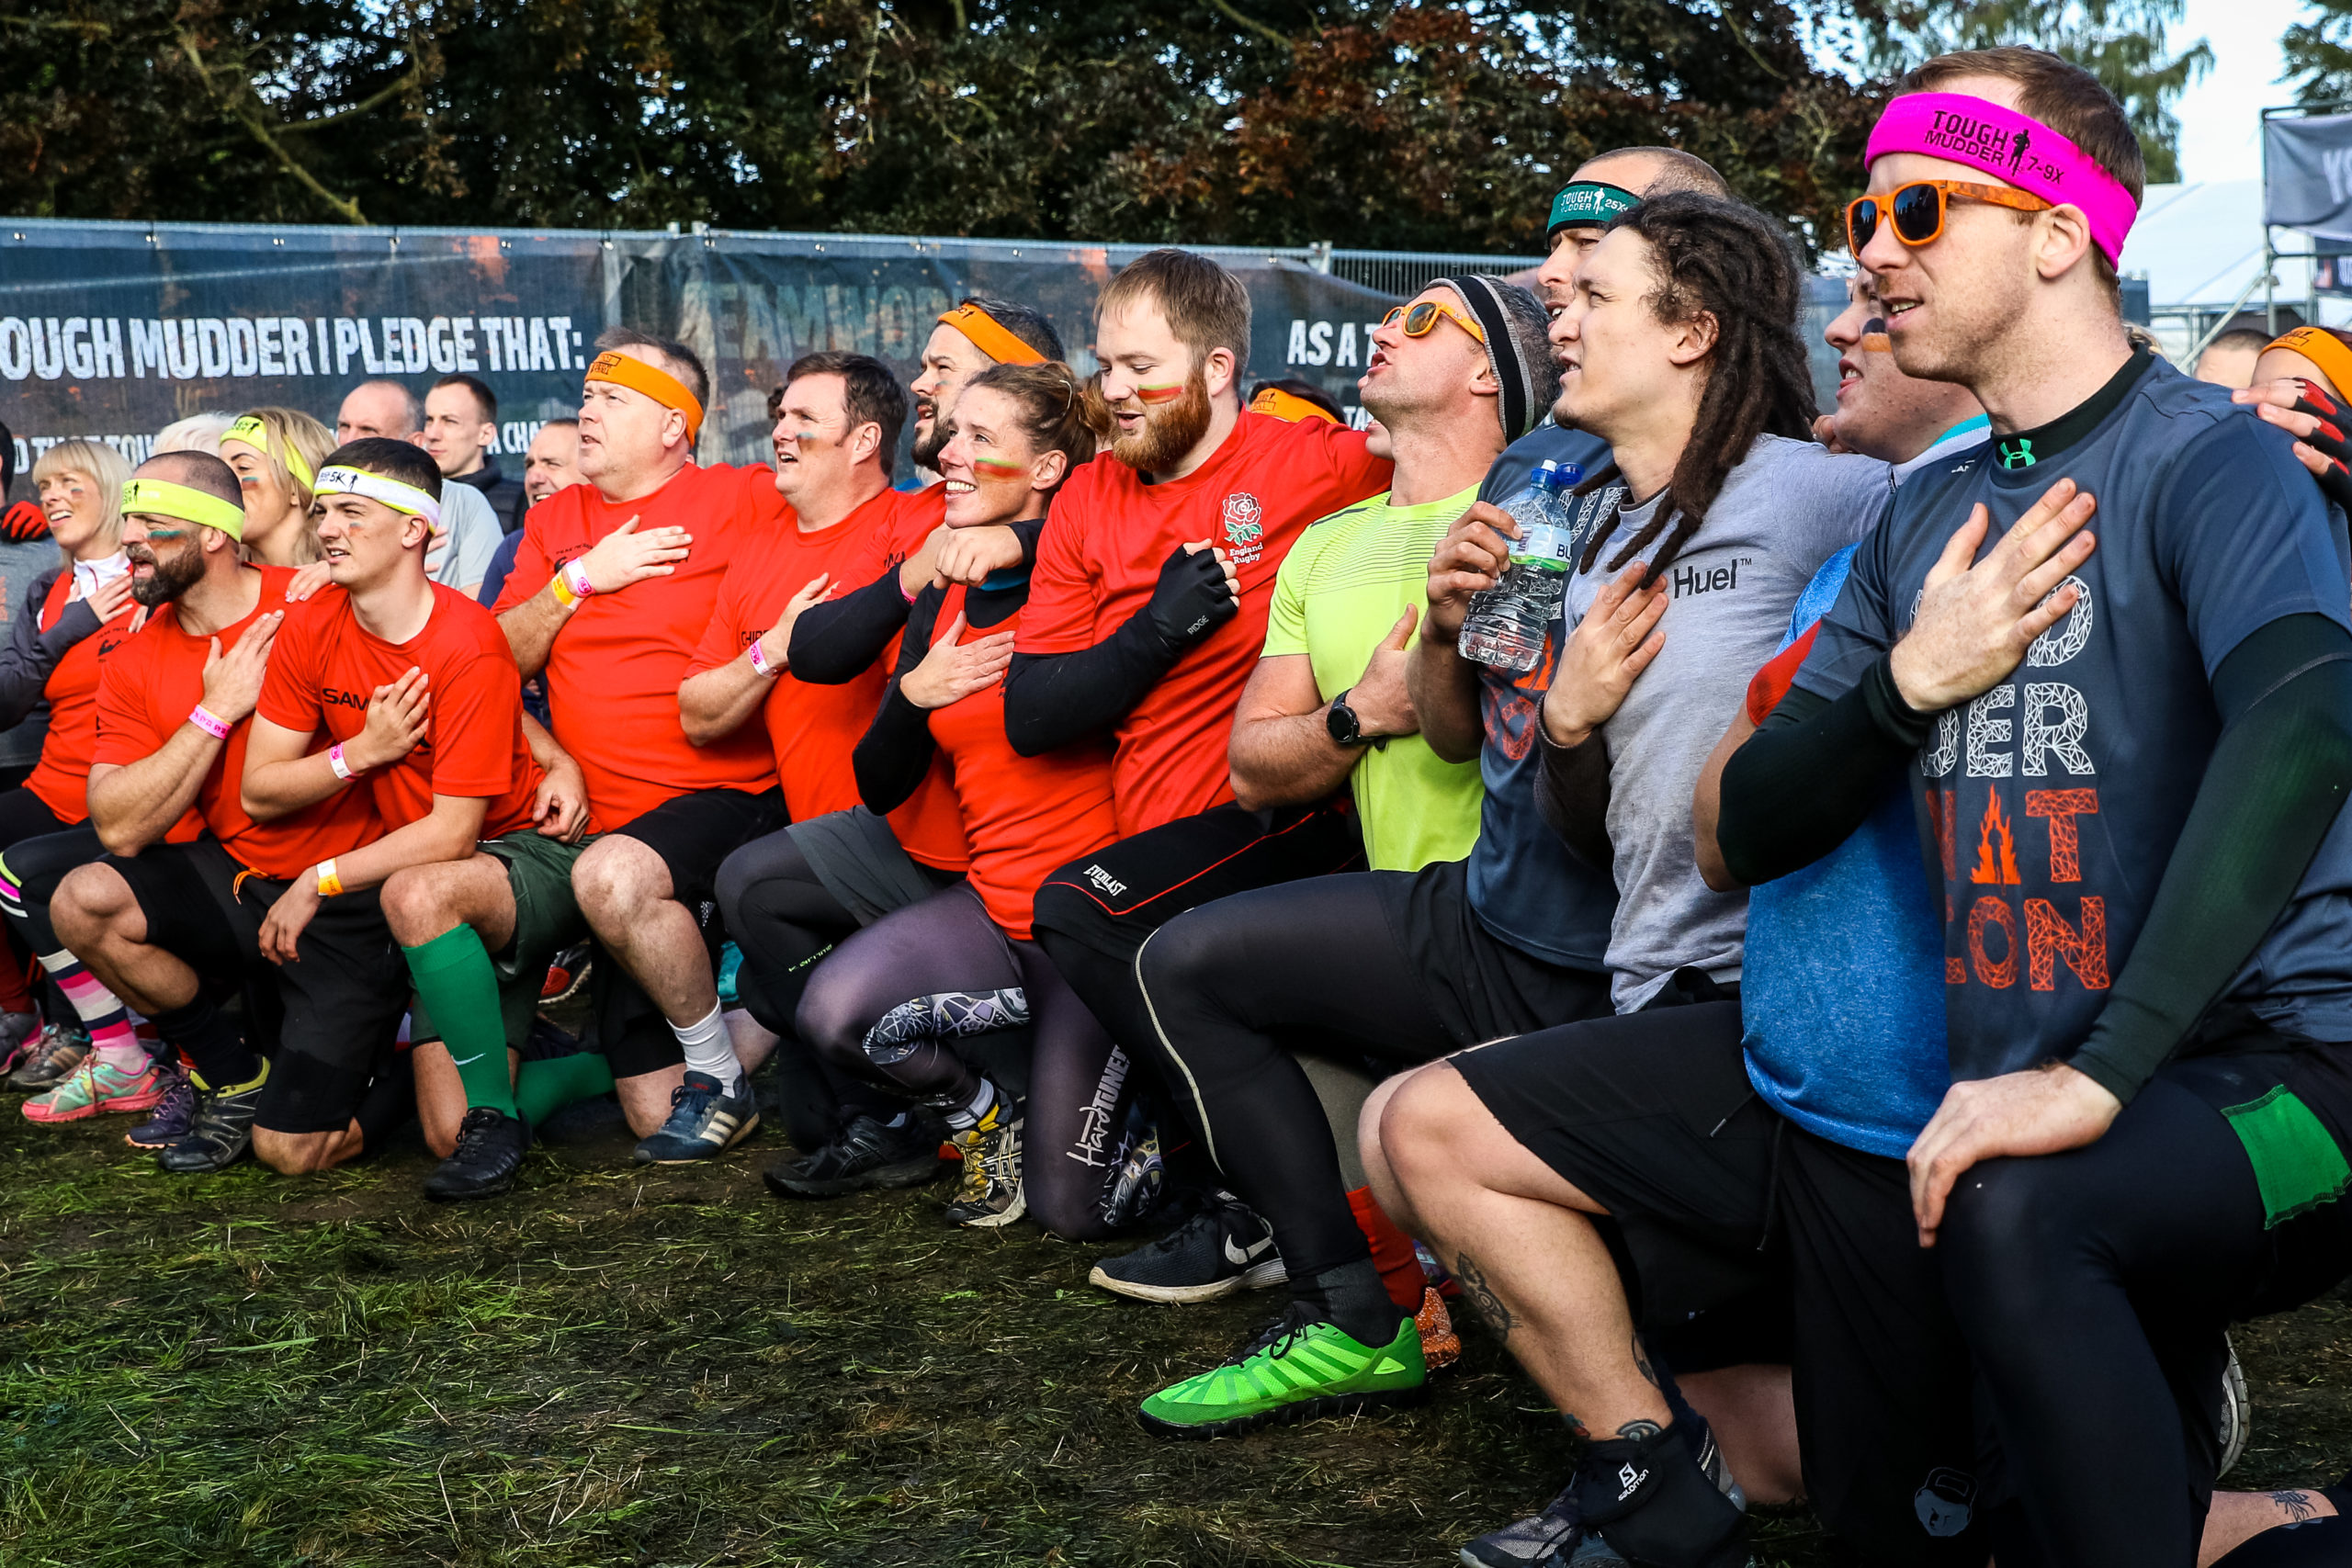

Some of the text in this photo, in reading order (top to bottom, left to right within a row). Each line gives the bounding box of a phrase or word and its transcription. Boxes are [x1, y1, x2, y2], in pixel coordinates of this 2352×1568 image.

[1933, 110, 2009, 151] TOUGH
[1925, 130, 2005, 166] MUDDER
[2028, 156, 2064, 184] 7-9X
[129, 317, 314, 379] MUDDER
[315, 317, 331, 375] I
[334, 316, 479, 375] PLEDGE
[479, 316, 585, 371] THAT:
[1287, 320, 1333, 366] AS
[1336, 322, 1357, 367] A
[1229, 542, 1263, 557] England
[1233, 553, 1261, 565] Rugby
[1674, 559, 1737, 599] Huel
[1187, 615, 1209, 635] RIDGE
[1082, 863, 1128, 897] EVERLAST
[1618, 1469, 1649, 1502] salomon
